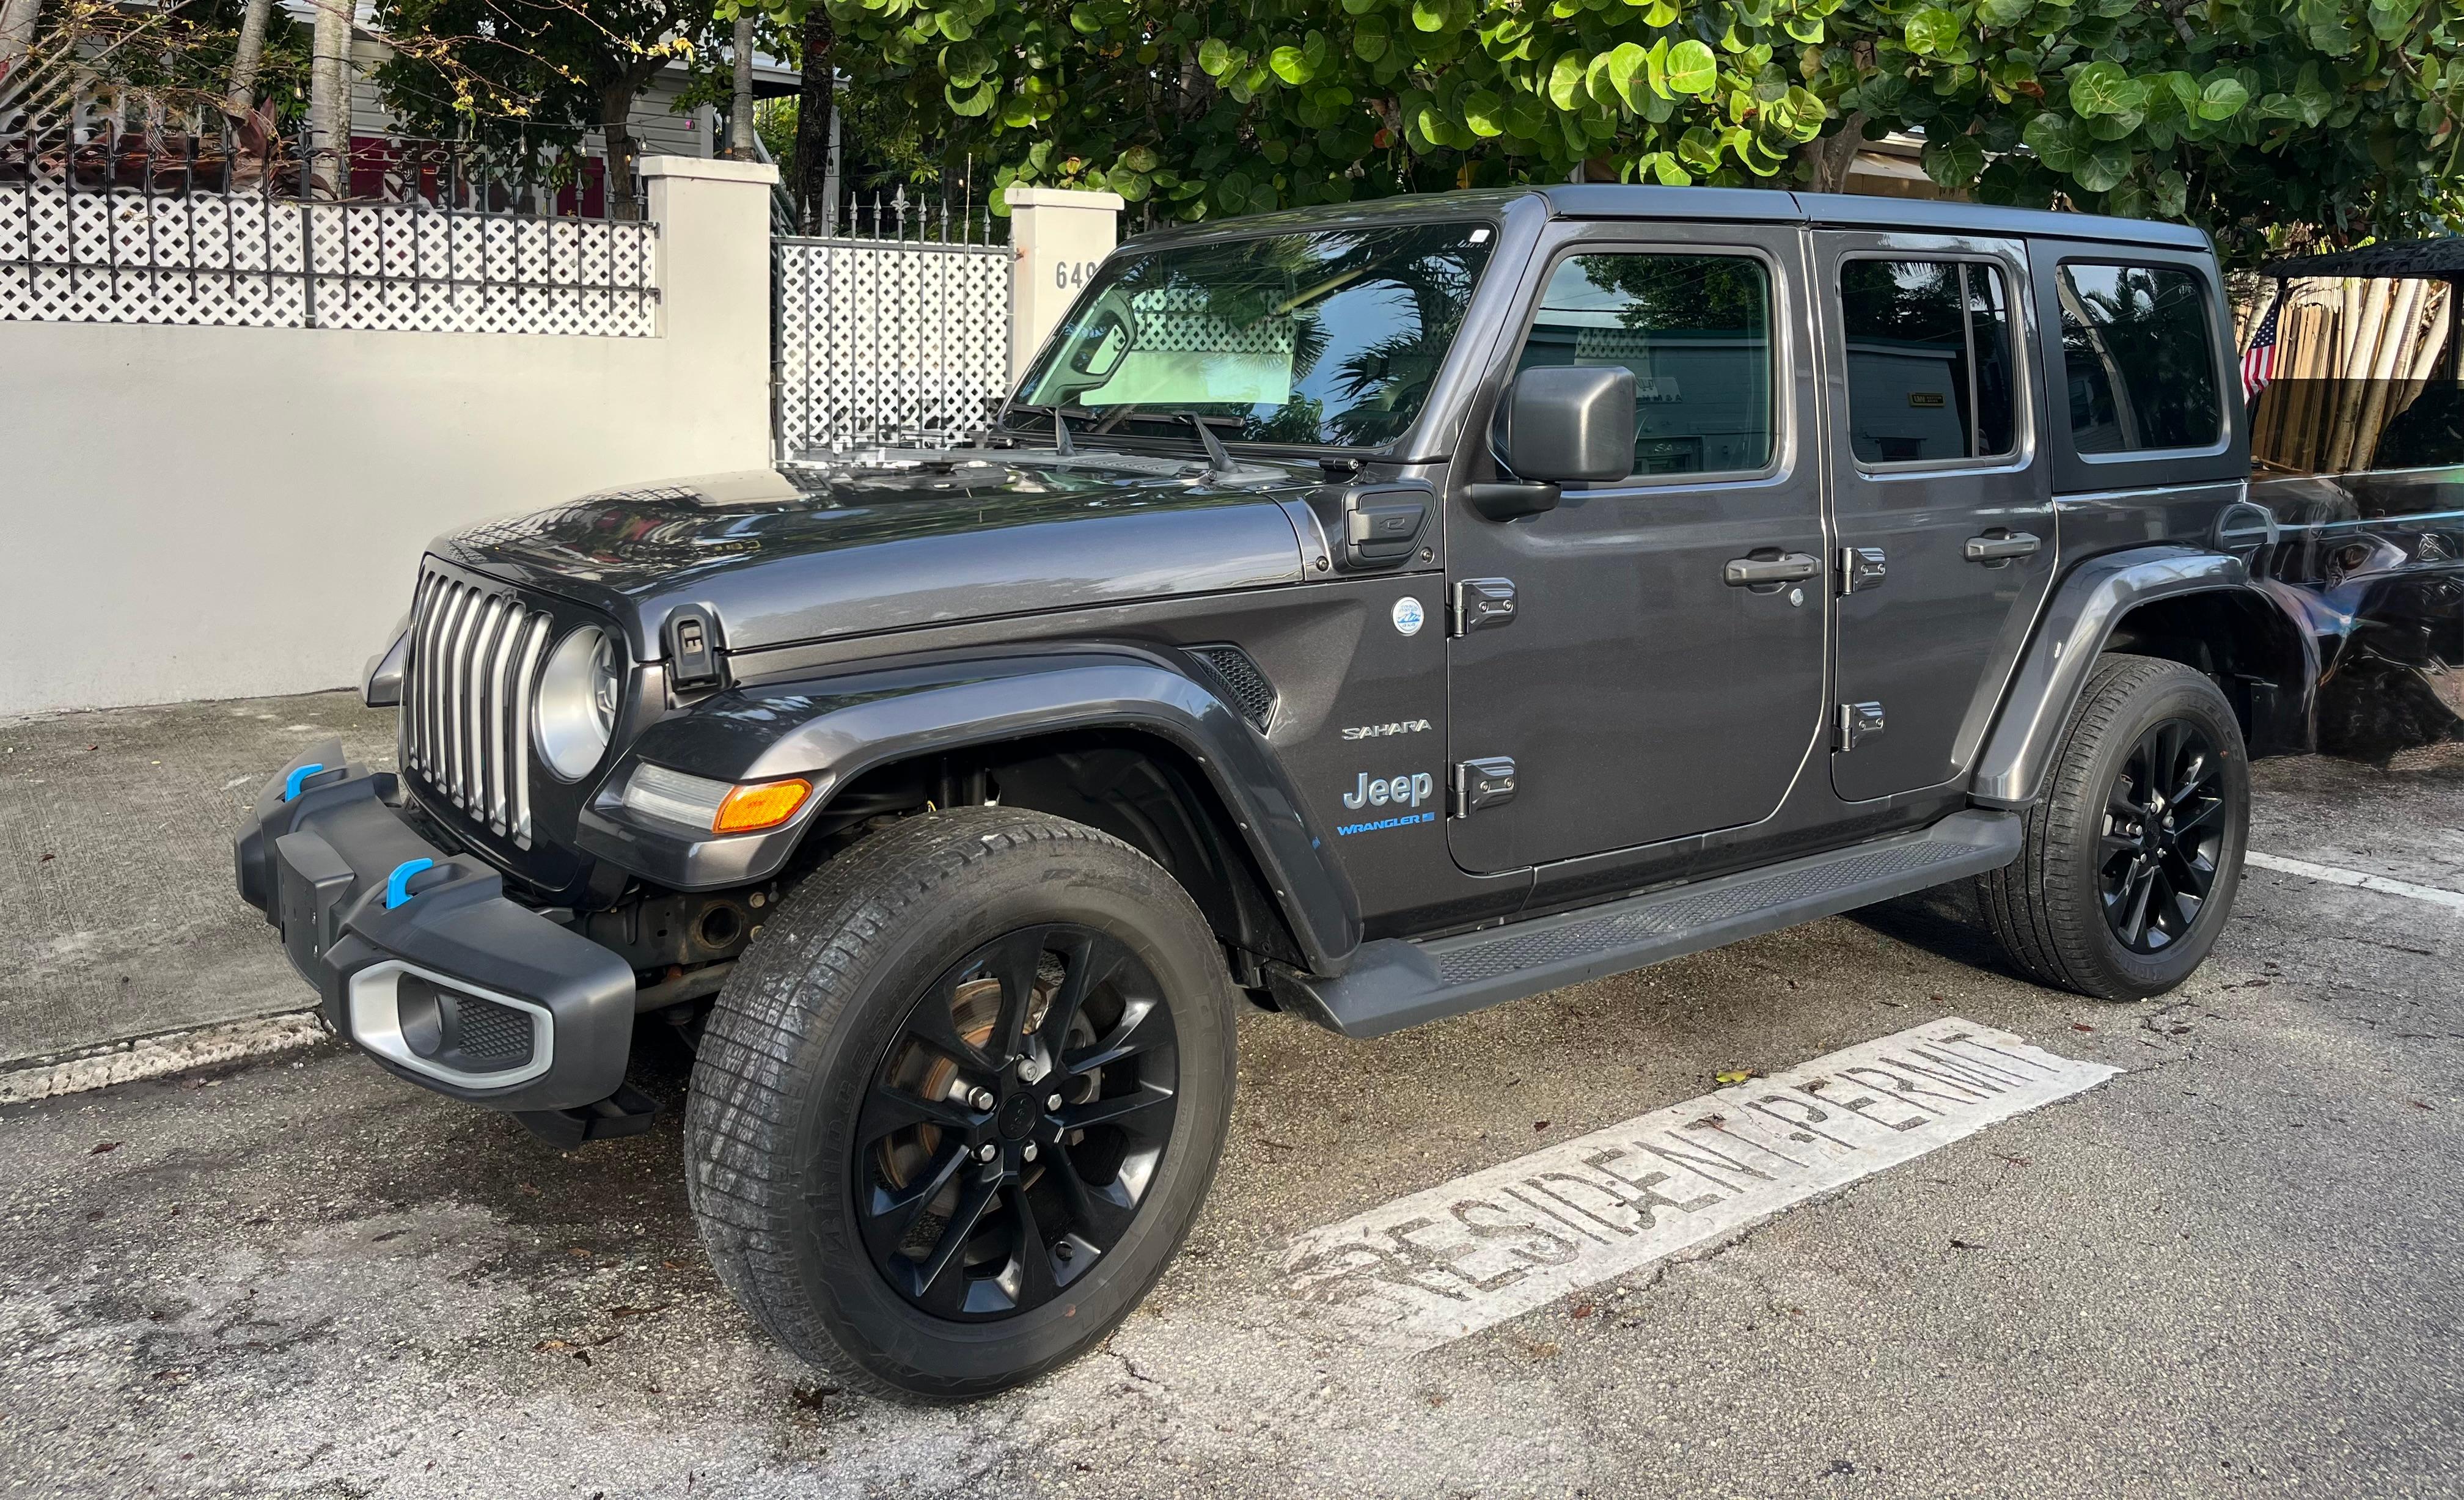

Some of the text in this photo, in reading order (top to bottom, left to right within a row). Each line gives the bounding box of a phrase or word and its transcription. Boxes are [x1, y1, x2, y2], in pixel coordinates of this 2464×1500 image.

[1341, 719, 1432, 740] SAHARA
[1343, 772, 1433, 810] Jeep
[1337, 814, 1420, 836] WRANGLER
[1745, 1033, 2061, 1151] PERMIT
